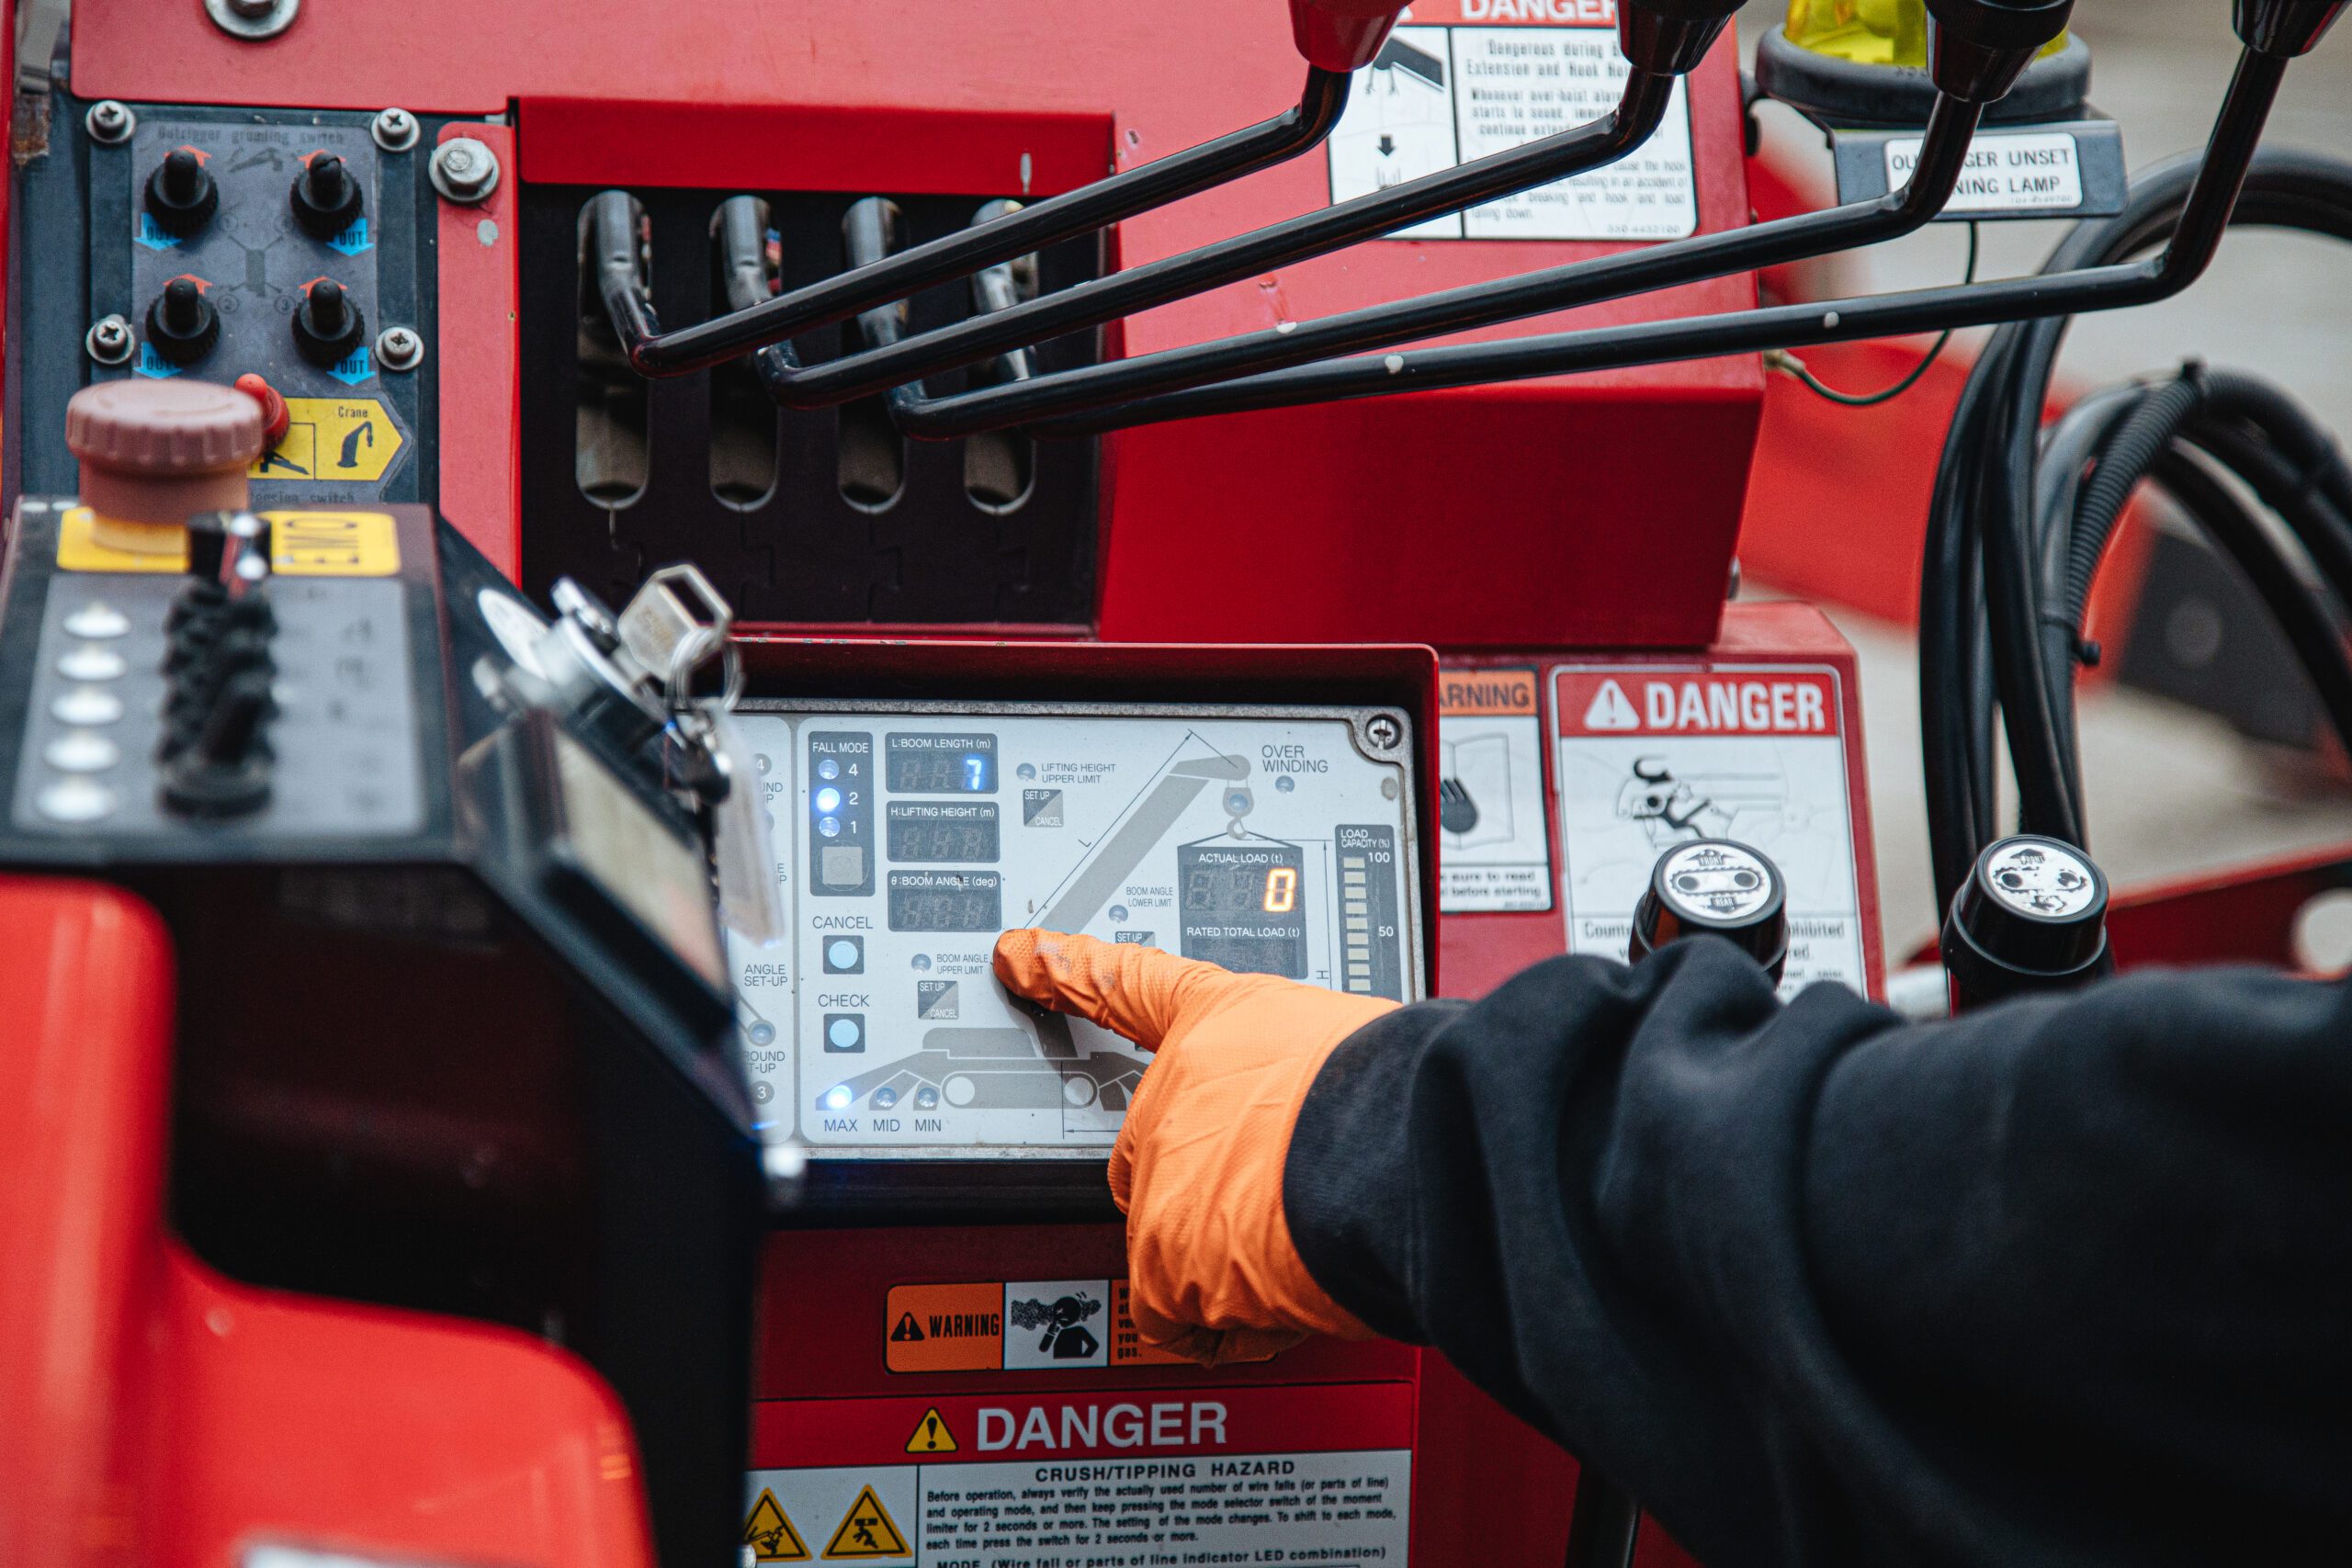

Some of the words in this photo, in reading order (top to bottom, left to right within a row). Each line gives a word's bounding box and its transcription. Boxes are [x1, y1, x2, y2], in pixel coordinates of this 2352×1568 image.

[2008, 149, 2070, 166] UNSET
[2009, 176, 2061, 192] LAMP
[338, 230, 364, 246] OUT
[340, 359, 364, 375] OUT
[337, 404, 368, 419] Crane
[1646, 682, 1826, 731] DANGER
[812, 742, 837, 753] FALL
[839, 742, 869, 753] MODE
[891, 739, 933, 749] L:BOOM
[934, 739, 974, 749] LENGTH
[976, 739, 991, 750] (m)
[1261, 745, 1305, 758] OVER
[757, 759, 764, 770] 4
[847, 763, 859, 776] 4
[1041, 763, 1078, 773] LIFTING
[1080, 763, 1116, 773] HEIGHT
[1262, 760, 1329, 773] WINDING
[966, 758, 982, 791] 7
[1042, 774, 1074, 784] UPPER
[1077, 774, 1102, 784] LIMIT
[848, 792, 859, 806] 2
[1024, 791, 1037, 800] SET
[1039, 791, 1050, 800] UP
[890, 807, 939, 818] H:LIFTING
[941, 807, 978, 818] HEIGHT
[979, 807, 995, 818] (m)
[850, 820, 856, 834] 1
[1035, 817, 1062, 827] CANCEL
[1340, 829, 1369, 840] LOAD
[1340, 839, 1378, 849] CAPACITY
[1379, 839, 1390, 849] (%)
[1198, 853, 1238, 863] ACTUAL
[1239, 853, 1269, 863] LOAD
[1271, 853, 1283, 864] (t)
[1367, 852, 1390, 863] 100
[935, 875, 970, 886] ANGLE
[972, 875, 997, 888] (deg)
[1125, 886, 1148, 897] BOOM
[1150, 886, 1173, 897] ANGLE
[1263, 867, 1296, 912] 0
[1127, 897, 1150, 907] LOWER
[1152, 897, 1172, 908] LIMIT
[812, 916, 874, 930] CANCEL
[1117, 932, 1130, 942] SET
[1132, 933, 1142, 942] UP
[1186, 927, 1222, 937] RATED
[1223, 927, 1251, 937] TOTAL
[1253, 927, 1284, 937] LOAD
[1288, 927, 1300, 938] (t)
[1378, 926, 1394, 937] 50
[936, 953, 959, 964] BOOM
[961, 953, 989, 964] ANGLE
[744, 964, 786, 976] ANGLE
[936, 965, 960, 975] UPPER
[963, 965, 984, 975] LIMIT
[744, 976, 788, 987] SET-UP
[920, 982, 933, 992] SET
[934, 982, 945, 992] UP
[818, 994, 870, 1008] CHECK
[930, 1009, 957, 1019] CANCEL
[823, 1119, 858, 1132] MAX
[873, 1119, 900, 1132] MID
[914, 1119, 943, 1132] MIN
[929, 1314, 1000, 1338] WARNING
[1118, 1347, 1143, 1359] gas.
[977, 1402, 1228, 1452] DANGER
[1035, 1463, 1196, 1483] CRUSH/TIPPING
[1211, 1461, 1295, 1477] HAZARD
[927, 1491, 960, 1502] Before
[966, 1488, 1016, 1502] operation,
[1022, 1488, 1055, 1501] always
[1061, 1486, 1090, 1500] verify
[1094, 1486, 1110, 1497] the
[1115, 1484, 1154, 1497] actually
[1160, 1483, 1184, 1495] used
[1190, 1483, 1227, 1494] number
[1233, 1481, 1243, 1492] of
[1248, 1480, 1269, 1492] wire
[1301, 1479, 1315, 1492] (or
[1320, 1479, 1346, 1492] parts
[1351, 1477, 1362, 1488] of
[1367, 1476, 1389, 1489] line)
[926, 1507, 945, 1518] and
[951, 1506, 999, 1519] operating
[1004, 1504, 1035, 1517] mode,
[1040, 1503, 1058, 1514] and
[1064, 1502, 1086, 1514] then
[1091, 1502, 1115, 1515] keep
[1121, 1500, 1164, 1514] pressing
[1170, 1498, 1185, 1510] the
[1191, 1498, 1218, 1509] mode
[1224, 1496, 1263, 1508] selector
[1269, 1495, 1301, 1507] switch
[1306, 1495, 1317, 1506] of
[1321, 1494, 1337, 1506] the
[1342, 1494, 1382, 1505] moment
[926, 1523, 958, 1534] limiter
[964, 1522, 978, 1533] for
[983, 1521, 989, 1532] 2
[995, 1520, 1037, 1532] seconds
[1043, 1521, 1053, 1530] or
[1058, 1519, 1087, 1531] more.
[1091, 1517, 1110, 1529] The
[1115, 1517, 1150, 1529] setting
[1159, 1516, 1170, 1527] of
[1174, 1515, 1190, 1526] the
[1195, 1514, 1223, 1526] mode
[1228, 1513, 1272, 1526] changes.
[1277, 1512, 1289, 1523] To
[1295, 1510, 1317, 1522] shift
[1321, 1510, 1332, 1521] to
[1337, 1509, 1361, 1520] each
[1365, 1508, 1396, 1521] mode,
[926, 1539, 949, 1550] each
[956, 1538, 977, 1549] time
[983, 1538, 1011, 1551] press
[1016, 1536, 1032, 1547] the
[1038, 1535, 1070, 1546] switch
[1075, 1534, 1090, 1545] for
[1095, 1534, 1102, 1544] 2
[1107, 1532, 1148, 1544] seconds
[1154, 1532, 1164, 1542] or
[1170, 1531, 1199, 1542] more.
[991, 1558, 1031, 1568] (Wire
[1035, 1557, 1060, 1568] fall
[1066, 1559, 1081, 1568] or
[1086, 1555, 1125, 1568] parts
[1130, 1553, 1145, 1566] of
[1150, 1552, 1177, 1565] line
[1182, 1551, 1250, 1564] indicator
[1255, 1551, 1284, 1562] LED
[1289, 1546, 1386, 1562] combination)
